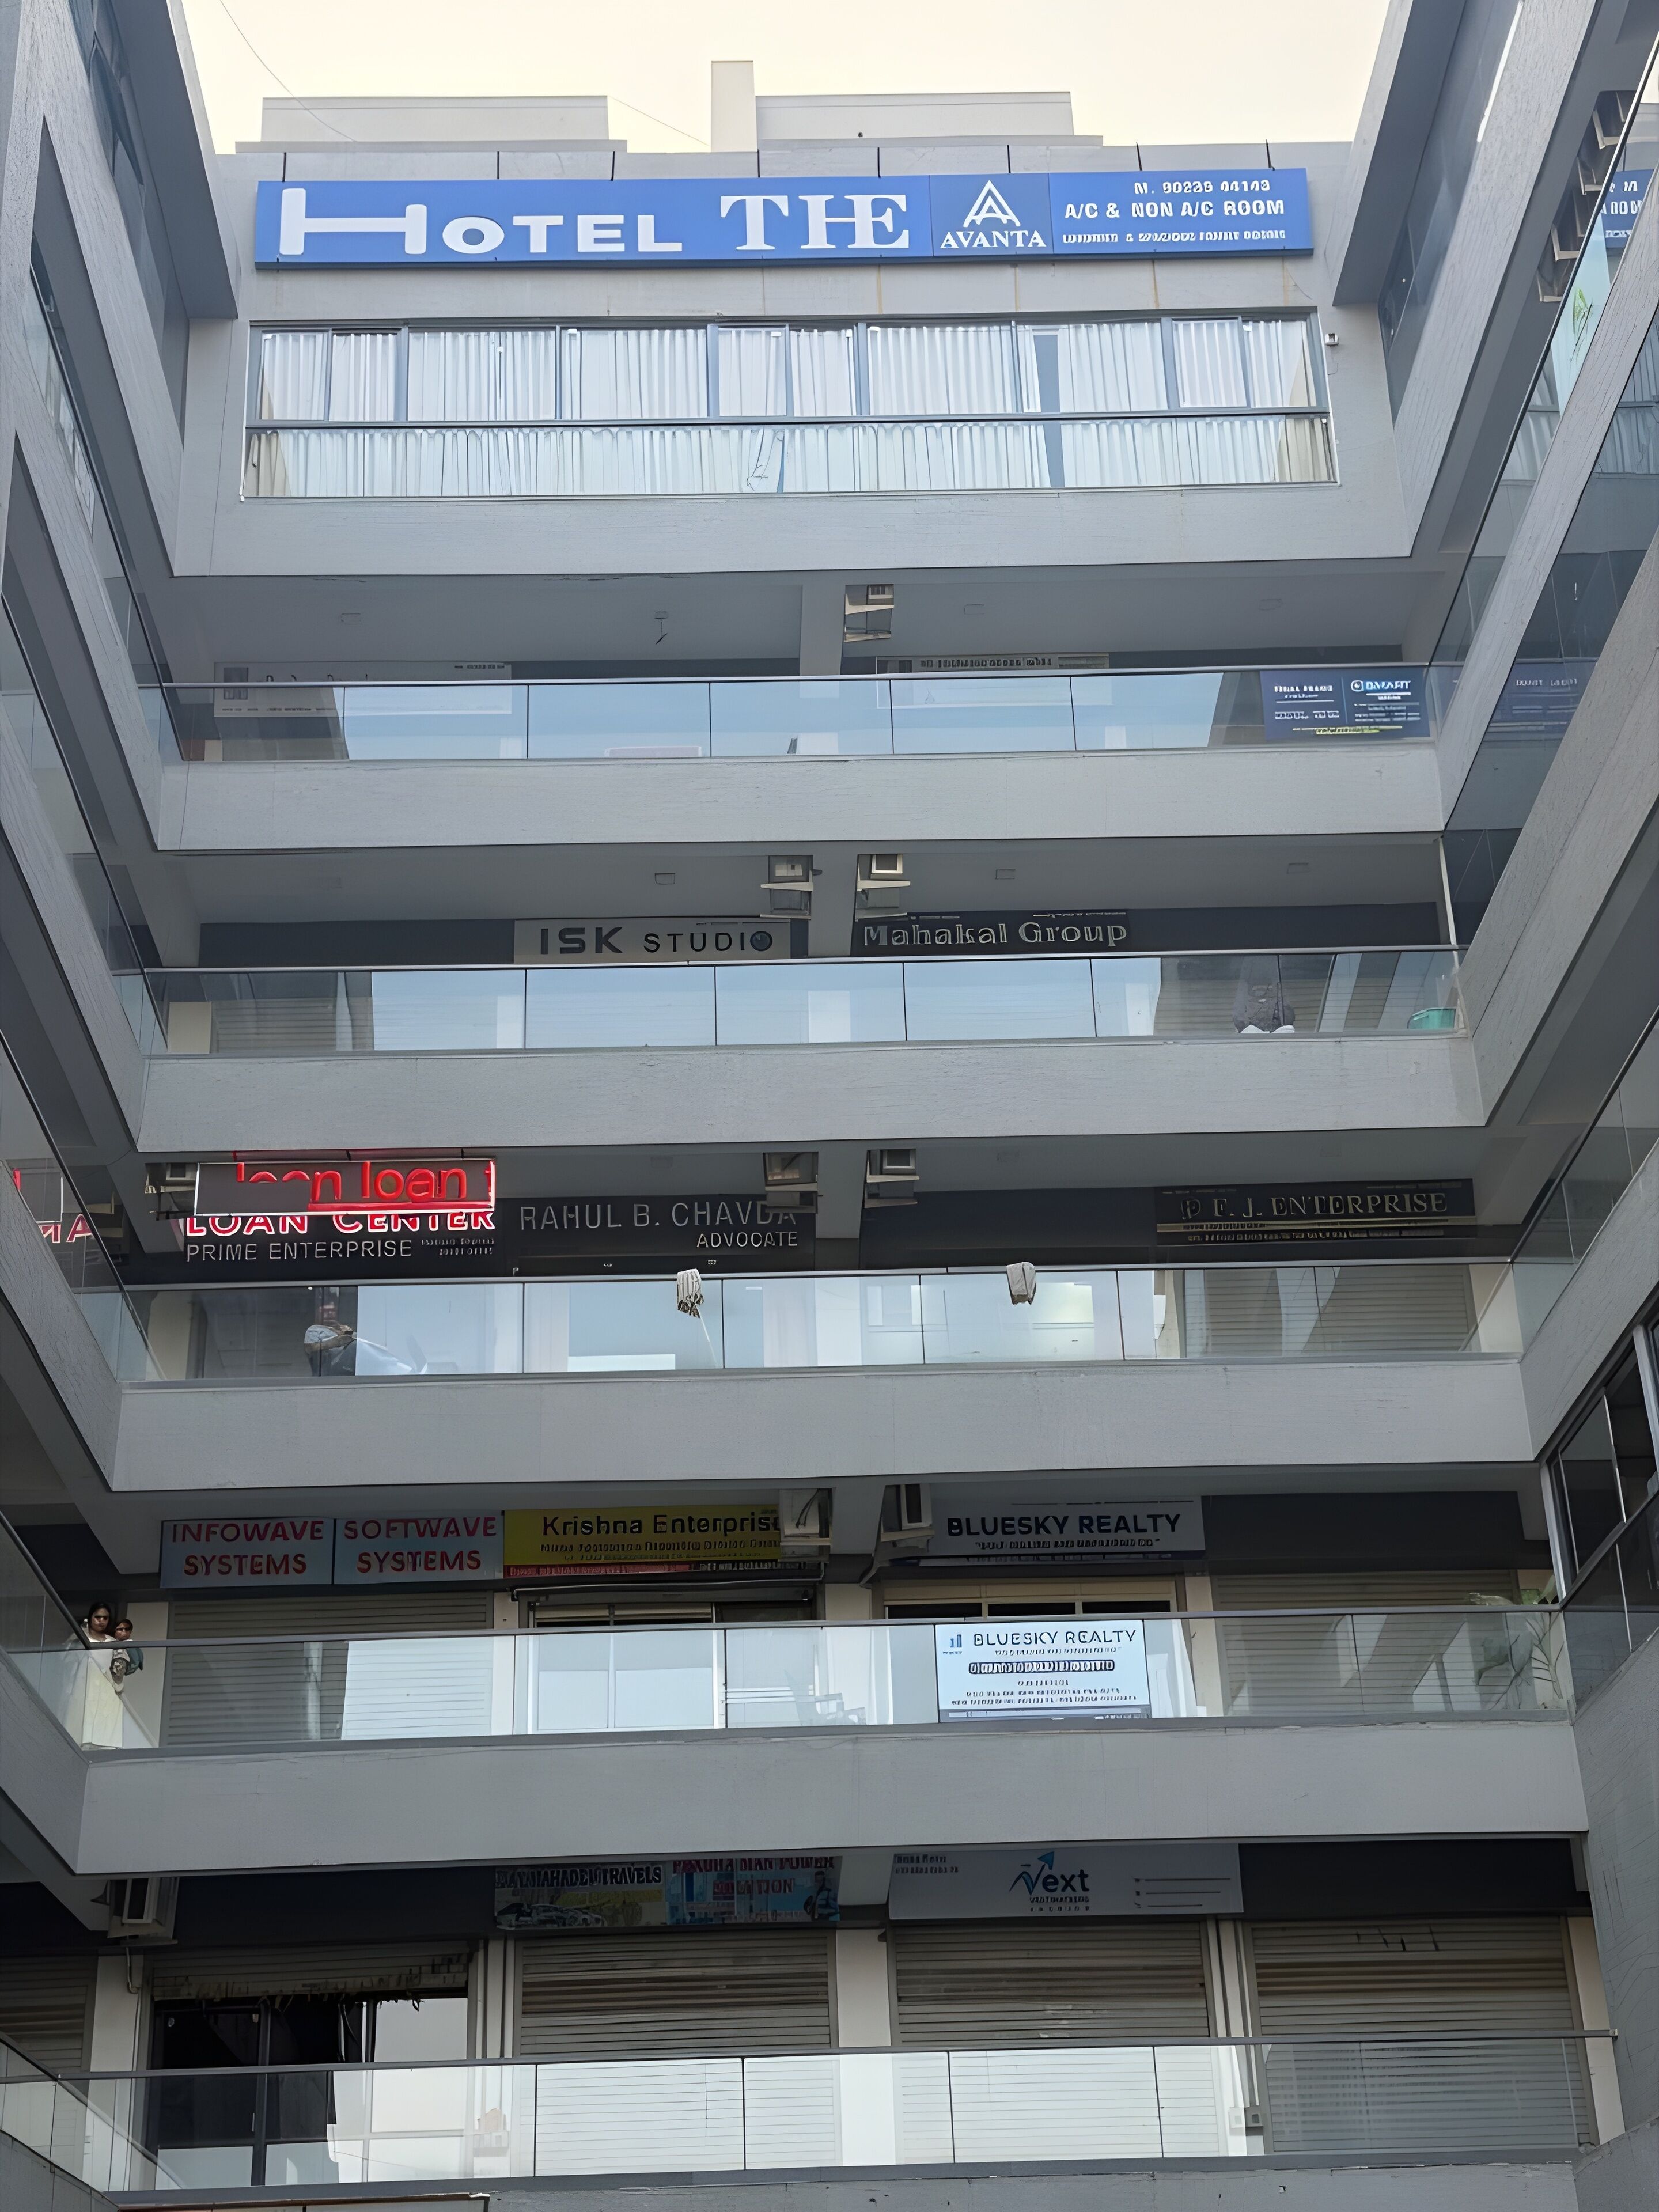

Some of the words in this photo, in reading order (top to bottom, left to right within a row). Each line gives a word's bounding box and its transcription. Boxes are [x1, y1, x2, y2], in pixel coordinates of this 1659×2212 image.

[1065, 203, 1098, 219] A/C
[1105, 203, 1120, 218] &
[1131, 202, 1173, 217] NON
[1181, 200, 1213, 217] A/C
[1224, 200, 1284, 215] ROOM
[280, 188, 682, 255] HOTEL
[721, 195, 909, 250] THE
[941, 230, 1046, 249] AVANTA
[541, 927, 623, 954] ISK
[644, 930, 772, 953] STUDIO
[865, 923, 1007, 945] Mahakal
[1018, 922, 1126, 946] Group
[361, 1161, 467, 1202] loan
[1271, 1193, 1447, 1215] ENTERPRISE
[186, 1215, 308, 1236] LOAN
[332, 1211, 495, 1233] CENTER
[521, 1204, 621, 1230] RAHUL
[634, 1204, 660, 1226] B.
[187, 1244, 257, 1262] PRIME
[270, 1240, 411, 1259] ENTERPRISE
[697, 1232, 797, 1248] ADVOCATE
[173, 1521, 324, 1542] INFOWAVE
[344, 1517, 496, 1540] SOFTWAVE
[542, 1516, 642, 1536] Krishna
[947, 1516, 1069, 1536] BLUESKY
[1078, 1514, 1180, 1534] REALTY
[183, 1553, 307, 1576] SYSTEMS
[356, 1550, 481, 1574] SYSTEMS
[974, 1631, 1058, 1646] BLUESKY
[1066, 1630, 1135, 1643] REALTY
[1009, 1858, 1090, 1895] Next
